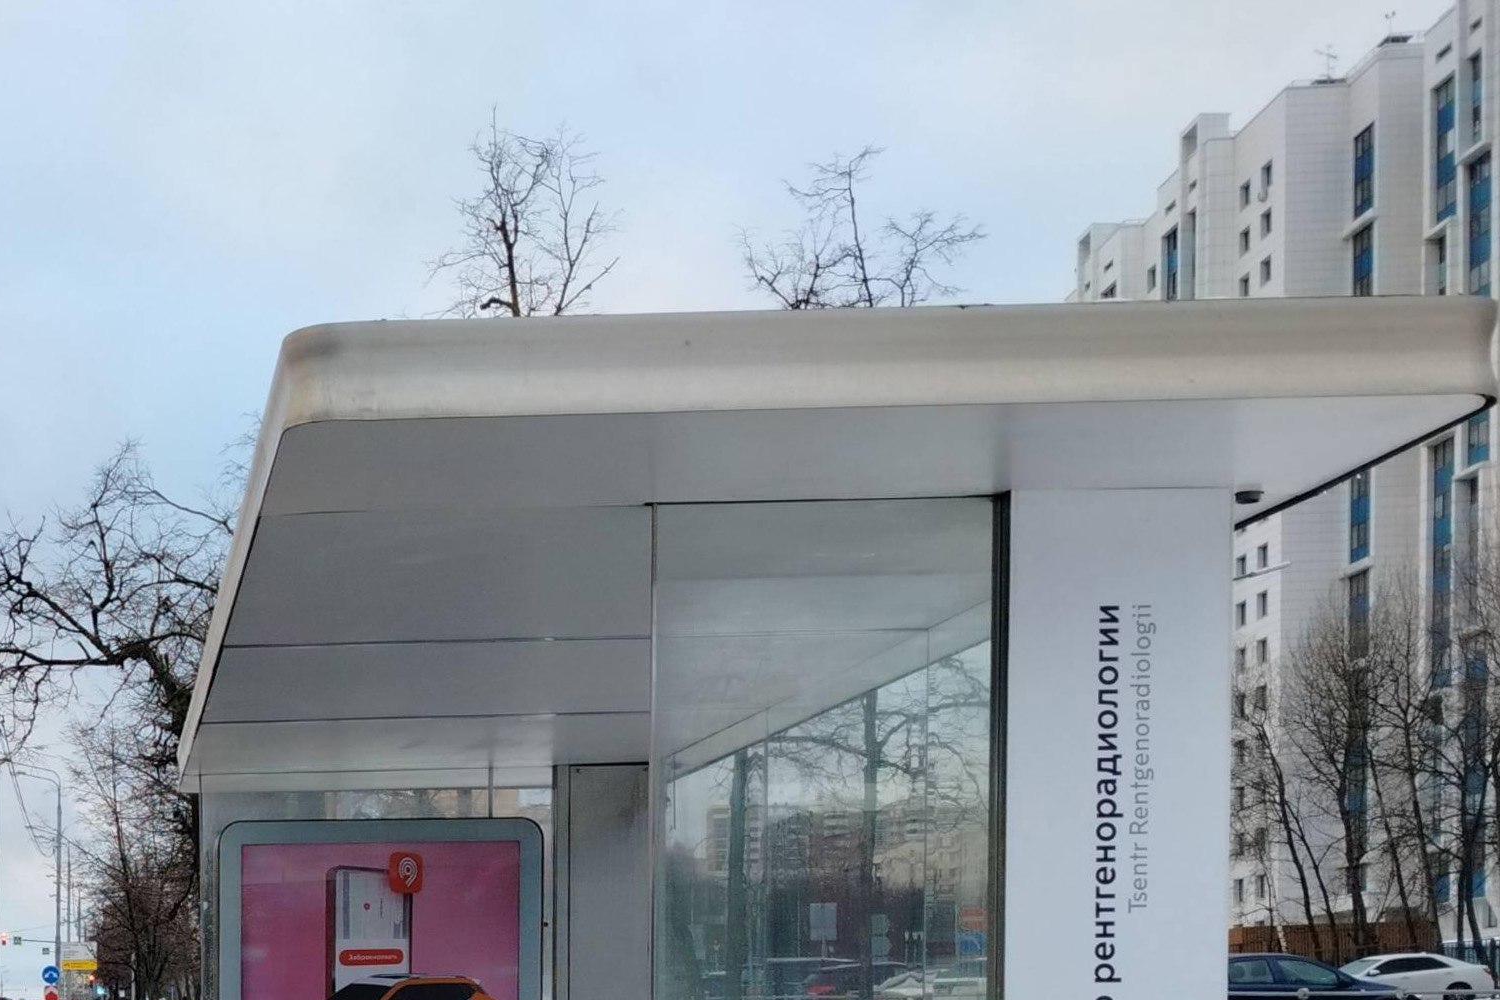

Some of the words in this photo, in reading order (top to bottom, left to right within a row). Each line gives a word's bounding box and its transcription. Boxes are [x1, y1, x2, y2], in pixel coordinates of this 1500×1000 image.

[1093, 605, 1124, 983] рентгенорадиологии
[1129, 603, 1157, 834] Rentgenoradiologii
[1128, 842, 1149, 913] Tsentr
